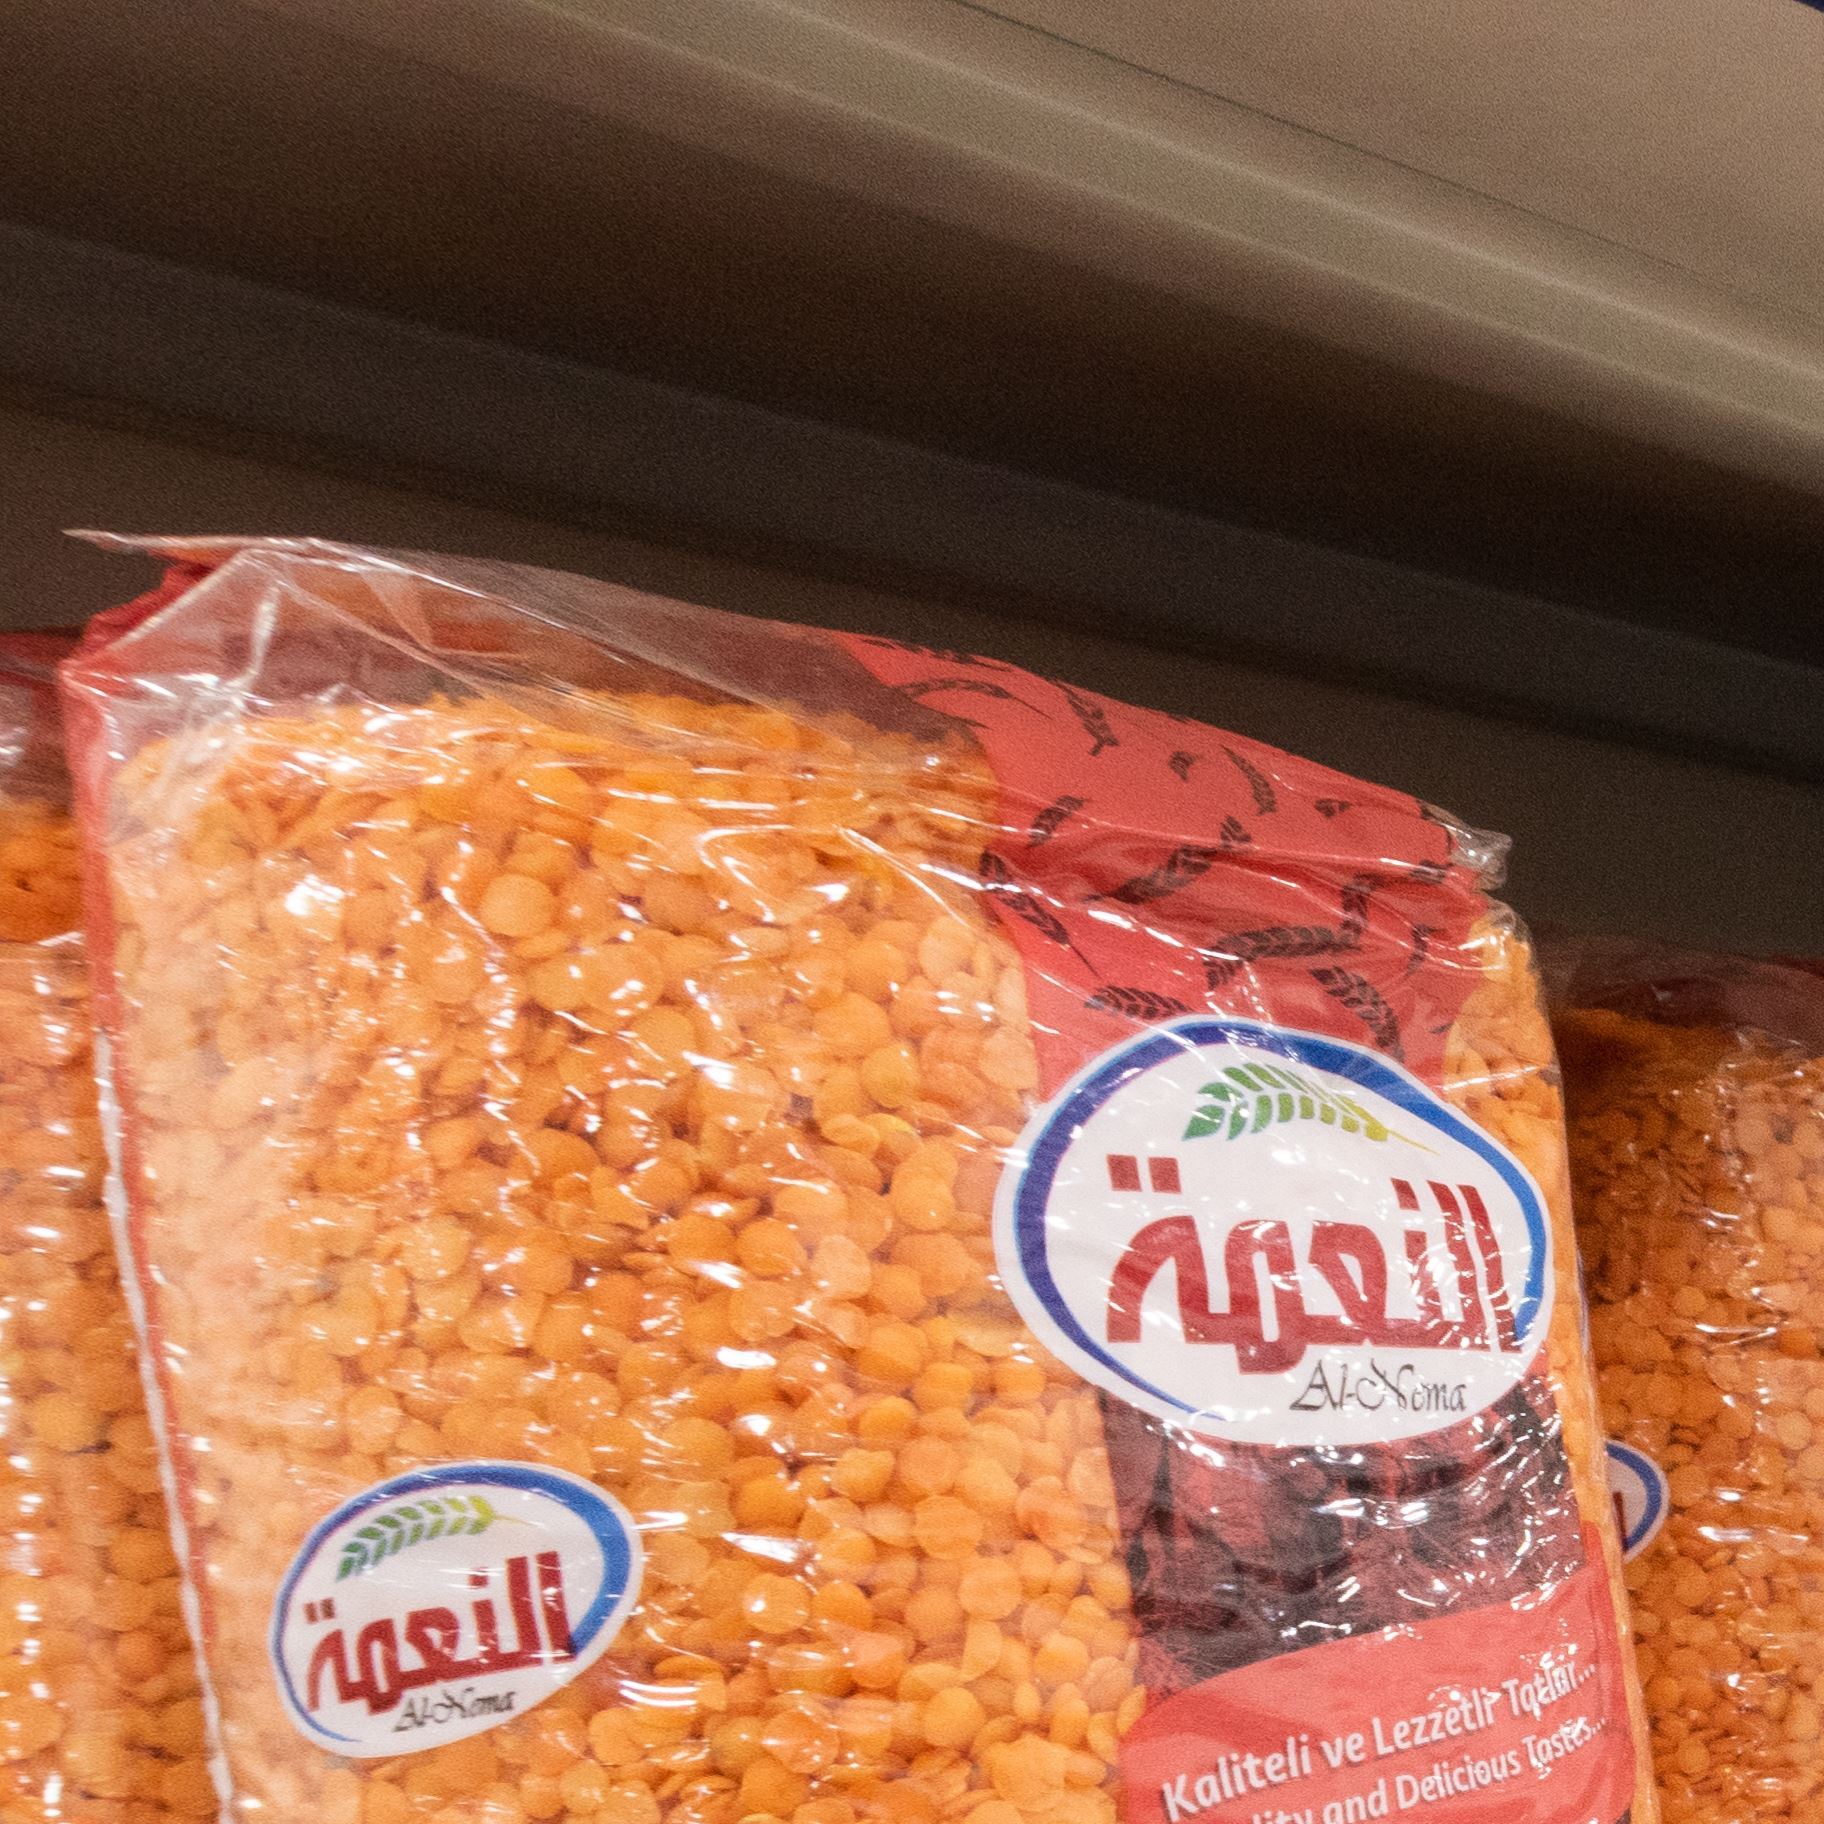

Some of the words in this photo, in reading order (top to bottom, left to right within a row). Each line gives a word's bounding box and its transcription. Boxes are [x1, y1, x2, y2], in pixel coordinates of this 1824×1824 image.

[1106, 1153, 1522, 1377] النعمة
[307, 1550, 578, 1716] النعمة
[1162, 1735, 1313, 1824] Kaliteli
[1322, 1733, 1366, 1769] ve
[1372, 1690, 1497, 1757] Lezzetli
[1396, 1750, 1521, 1811] Delicious
